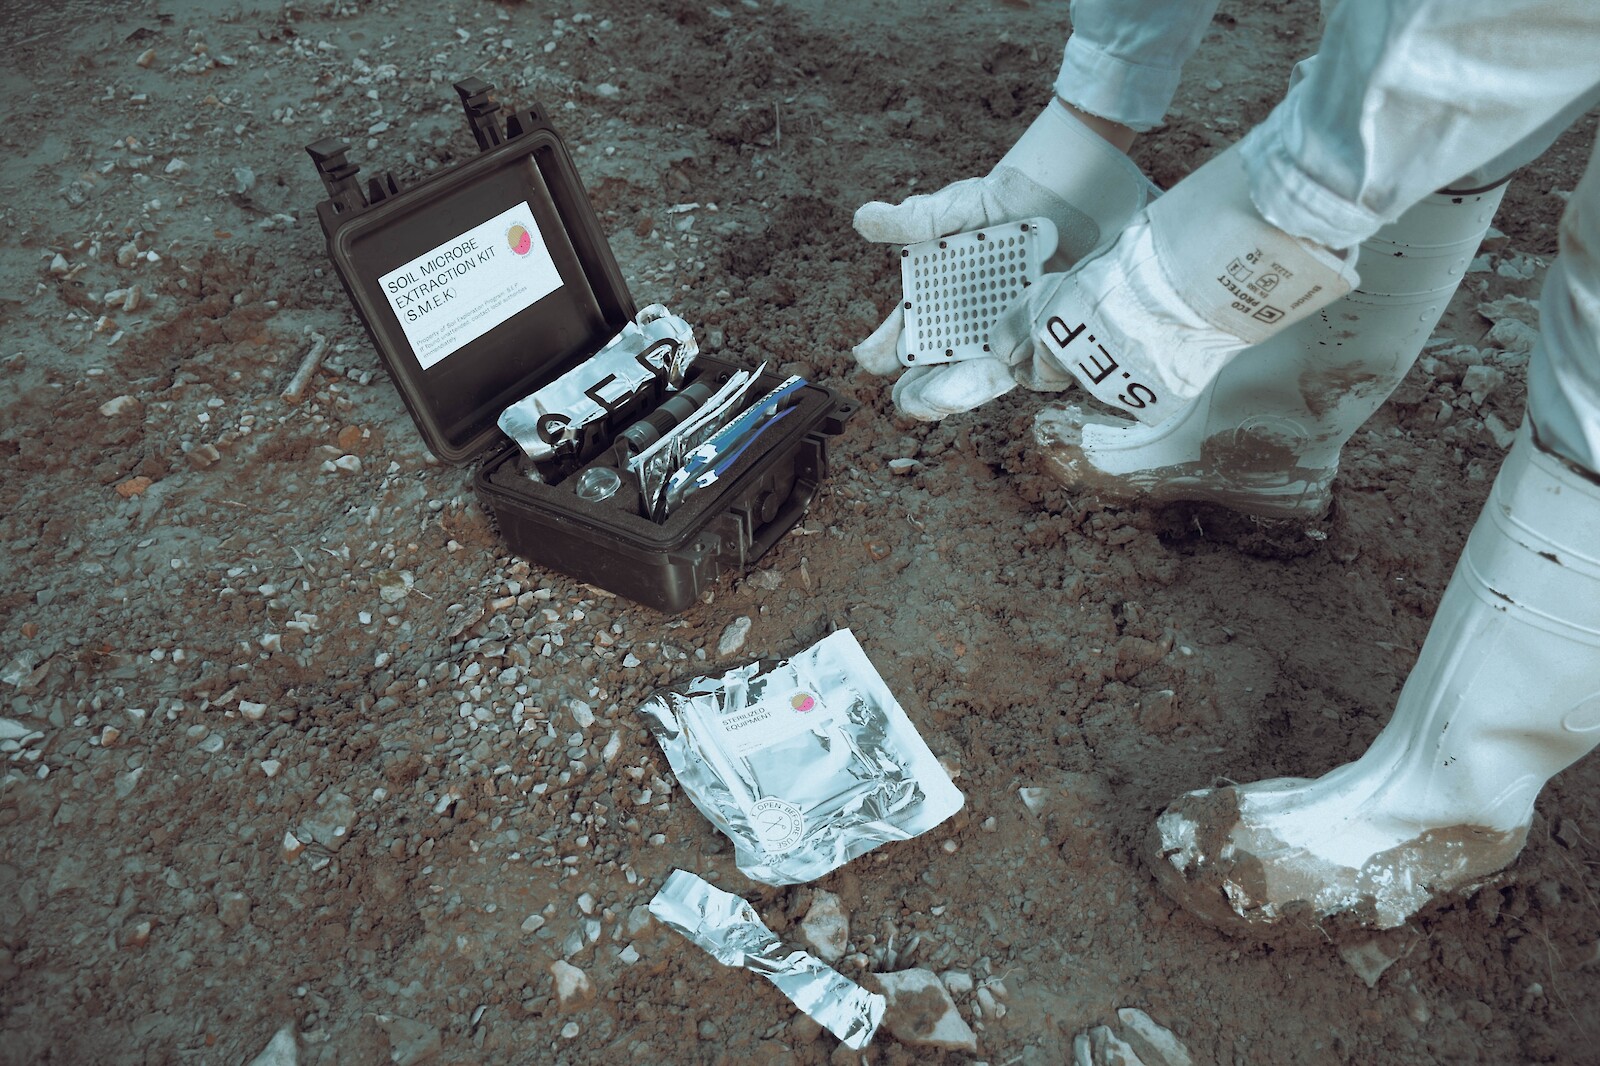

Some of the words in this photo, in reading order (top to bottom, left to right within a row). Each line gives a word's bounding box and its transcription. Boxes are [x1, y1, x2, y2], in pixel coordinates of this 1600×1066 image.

[387, 272, 419, 294] SOIL
[419, 237, 479, 277] MICROBE
[1246, 253, 1259, 264] 10
[395, 257, 476, 309] EXTRACTION
[478, 245, 496, 264] KIT
[1217, 275, 1260, 307] PROTECT
[403, 286, 457, 325] (S.M.E.K)
[1231, 301, 1251, 314] ECO
[1290, 285, 1322, 309] Builder
[416, 331, 439, 346] Property
[440, 325, 447, 333] of
[424, 337, 441, 350] found
[471, 307, 490, 322] contact
[1046, 315, 1157, 409] S.E.P
[722, 707, 766, 726] STERILIZED
[725, 712, 772, 731] EQUIPMENT
[757, 802, 782, 811] OPEN
[784, 807, 800, 835] BEFORE
